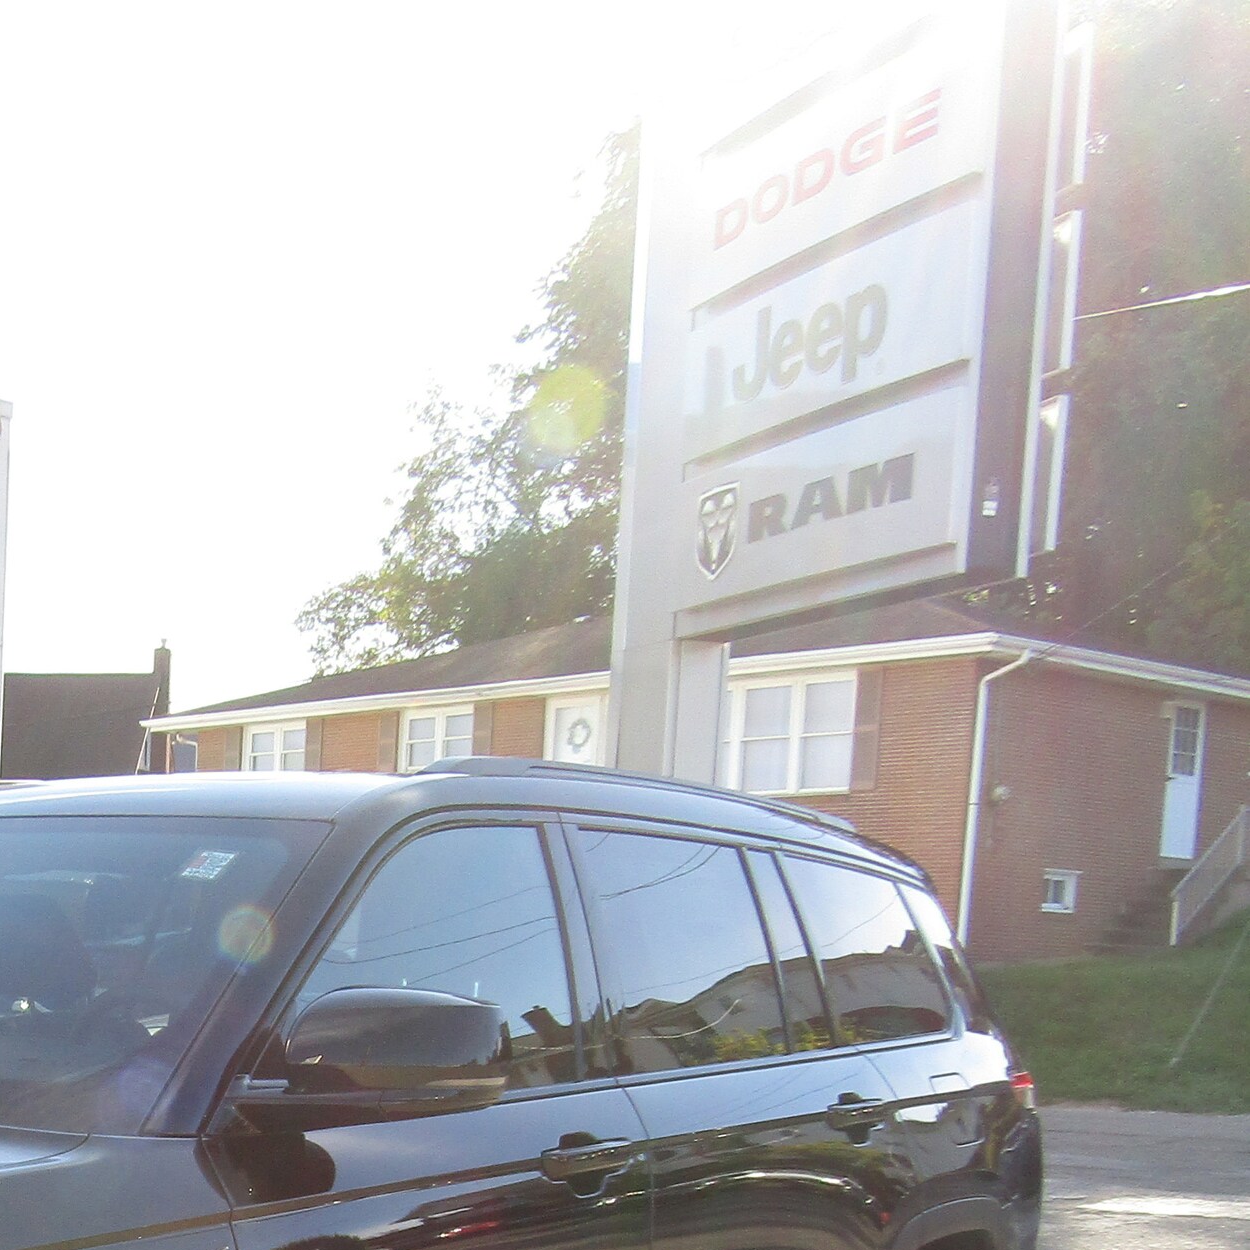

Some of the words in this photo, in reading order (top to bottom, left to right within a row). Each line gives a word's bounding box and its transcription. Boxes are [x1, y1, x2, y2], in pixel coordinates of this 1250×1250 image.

[713, 87, 942, 251] DODGE
[733, 284, 887, 402] Jeep
[748, 452, 916, 544] RAM
